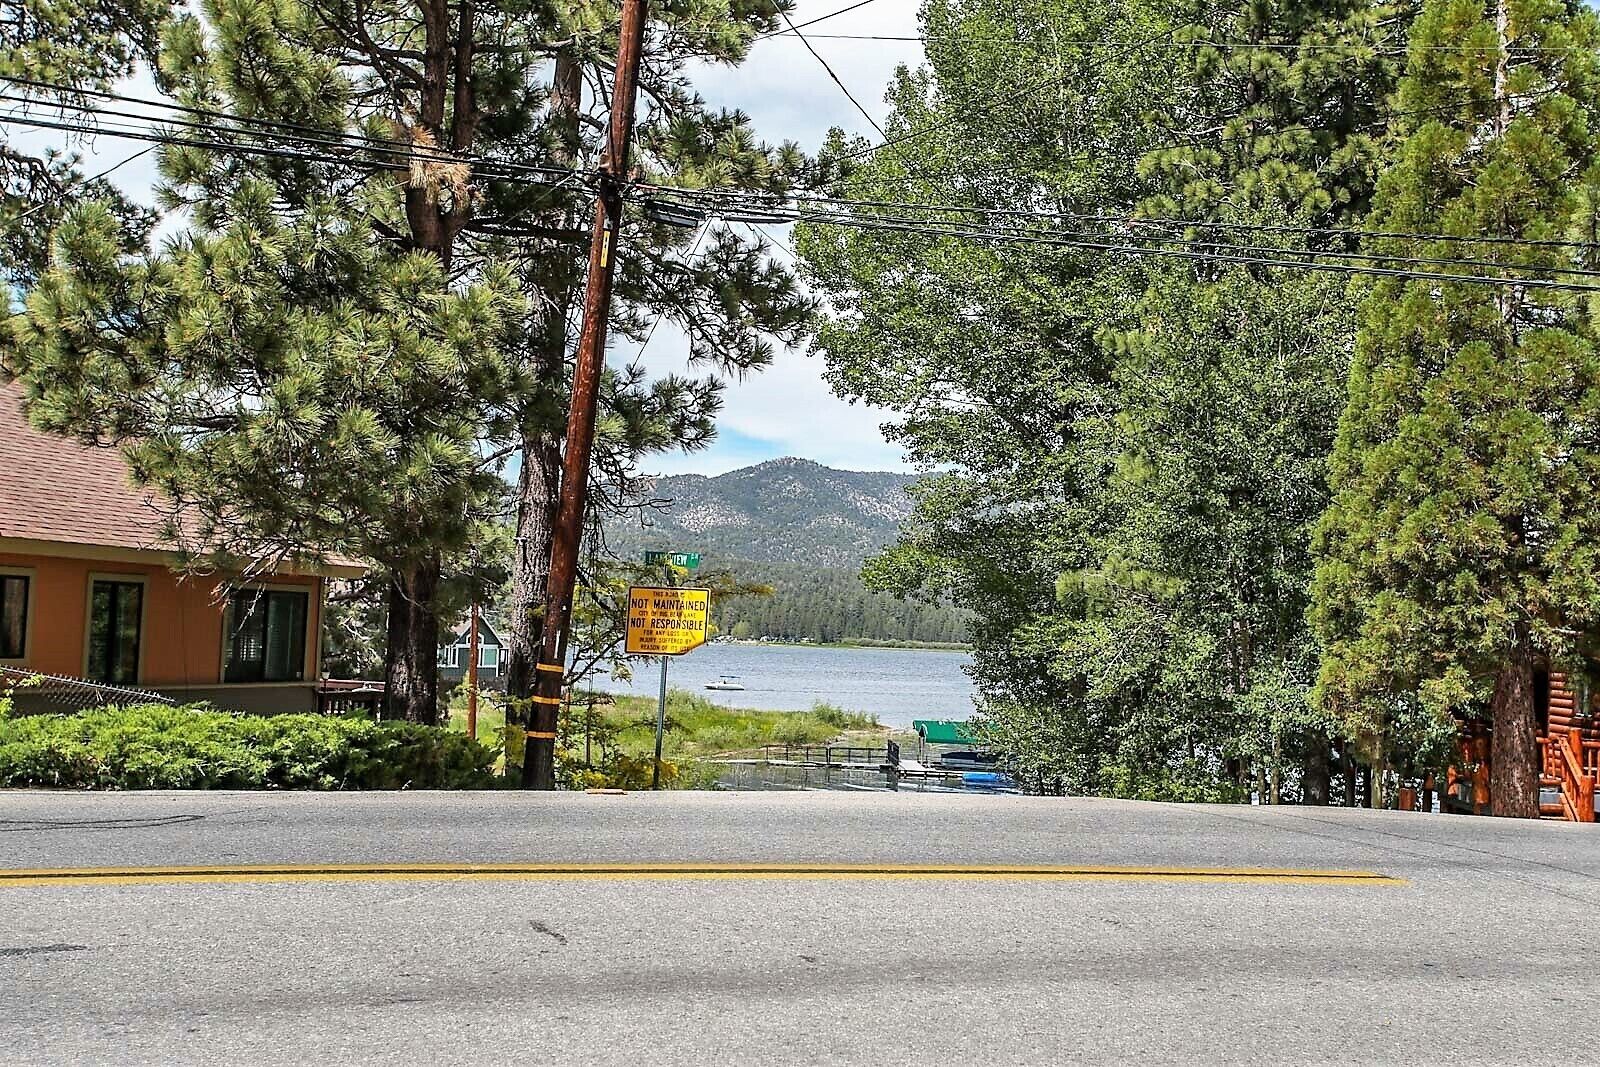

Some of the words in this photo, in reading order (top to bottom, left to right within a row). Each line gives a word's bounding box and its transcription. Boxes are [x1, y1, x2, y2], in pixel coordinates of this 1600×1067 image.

[631, 598, 649, 608] NOT
[654, 599, 706, 611] MAINTAINED
[630, 617, 646, 628] NOT
[651, 619, 703, 630] RESPONSIBLE
